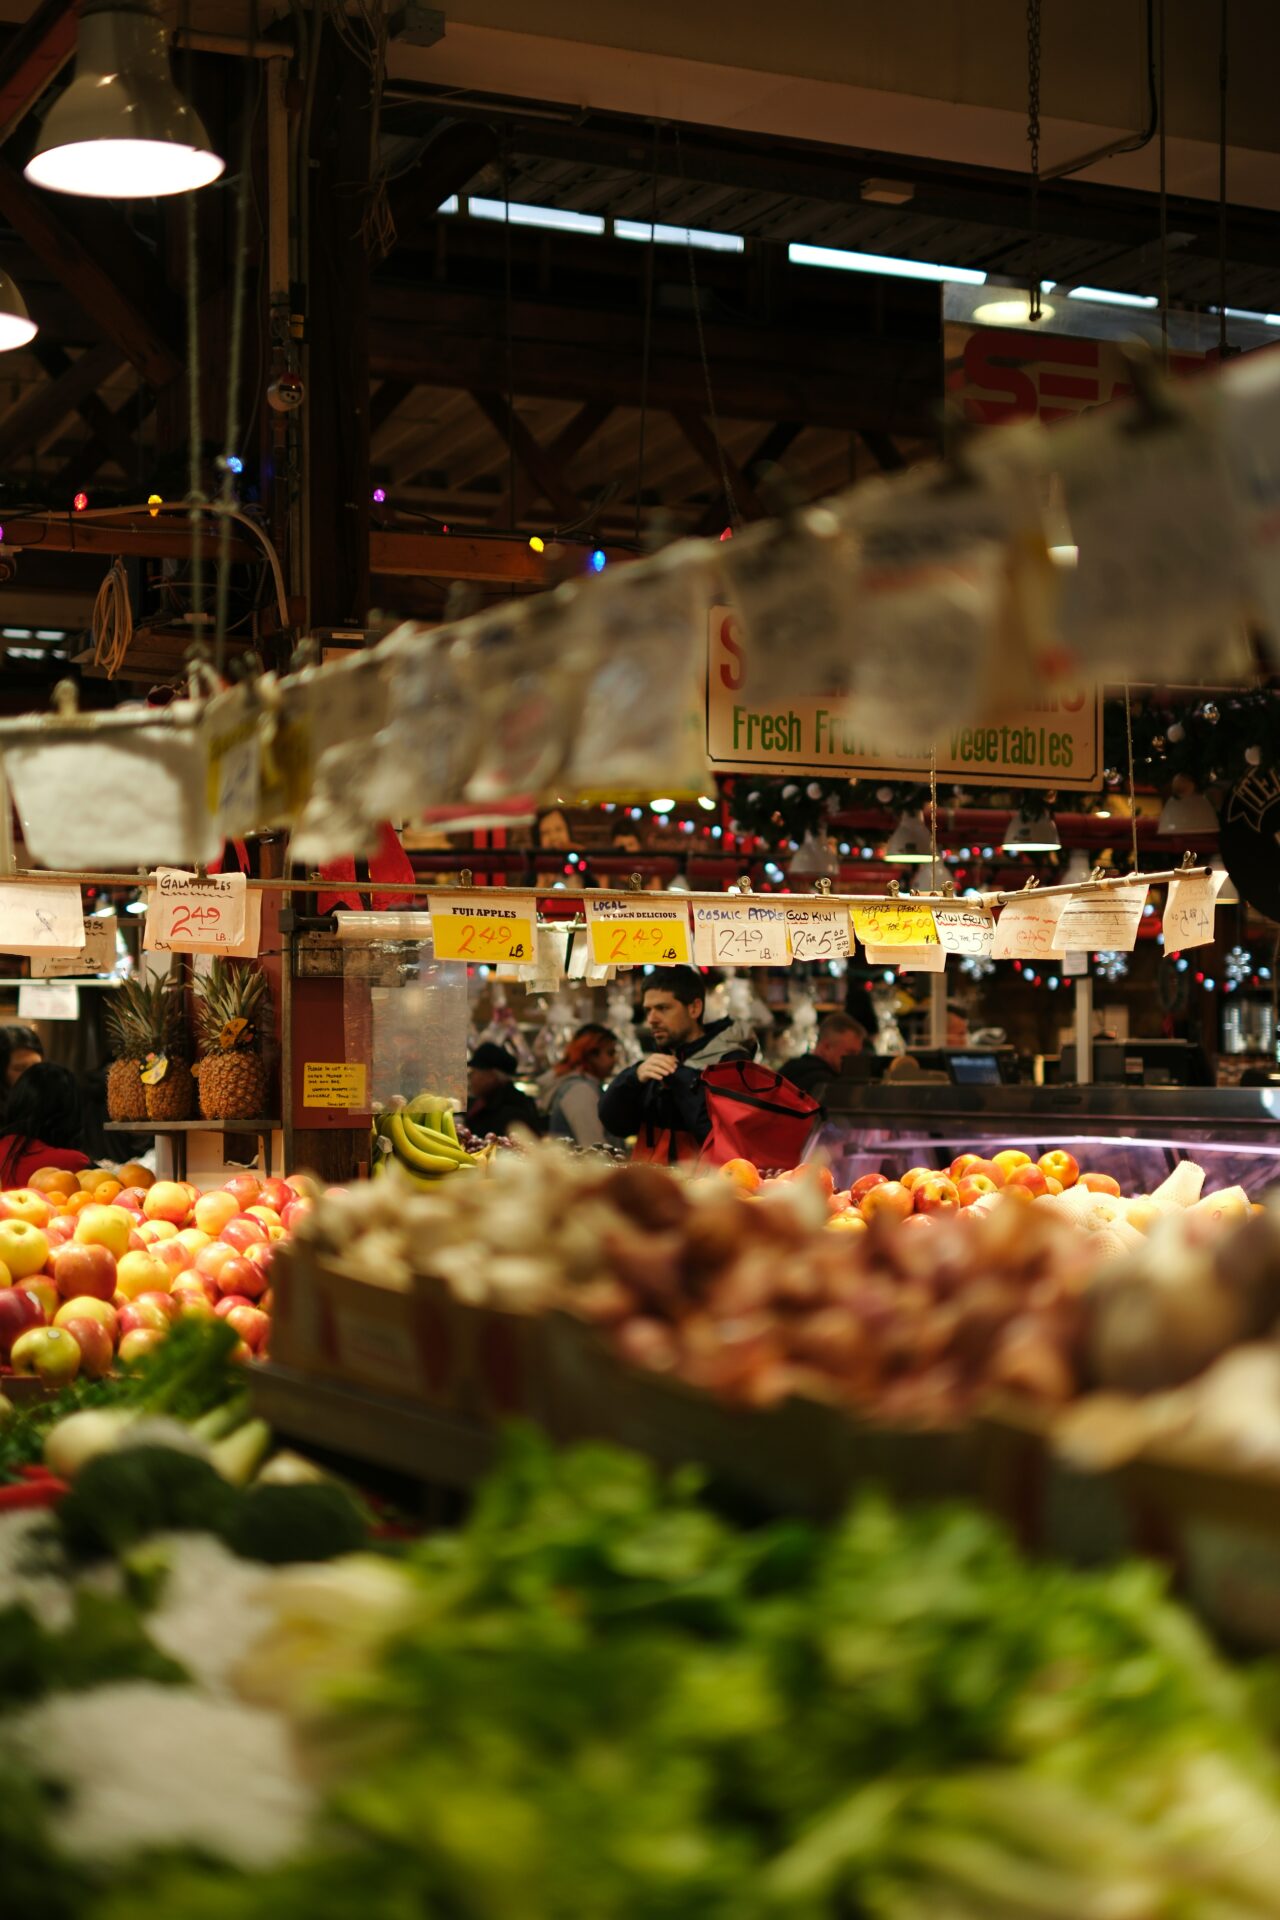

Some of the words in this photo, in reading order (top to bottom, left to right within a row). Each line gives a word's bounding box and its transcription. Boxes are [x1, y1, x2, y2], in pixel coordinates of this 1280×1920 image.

[733, 705, 801, 752] Fresh
[593, 900, 627, 911] LOCAL
[452, 907, 474, 916] FUJI
[476, 908, 517, 918] APPLES
[698, 909, 742, 920] COSMIC
[811, 912, 837, 922] KIWI
[868, 919, 884, 941] 3
[793, 931, 806, 957] 2
[944, 931, 960, 951] 3
[509, 944, 524, 957] LB
[662, 948, 677, 959] LB
